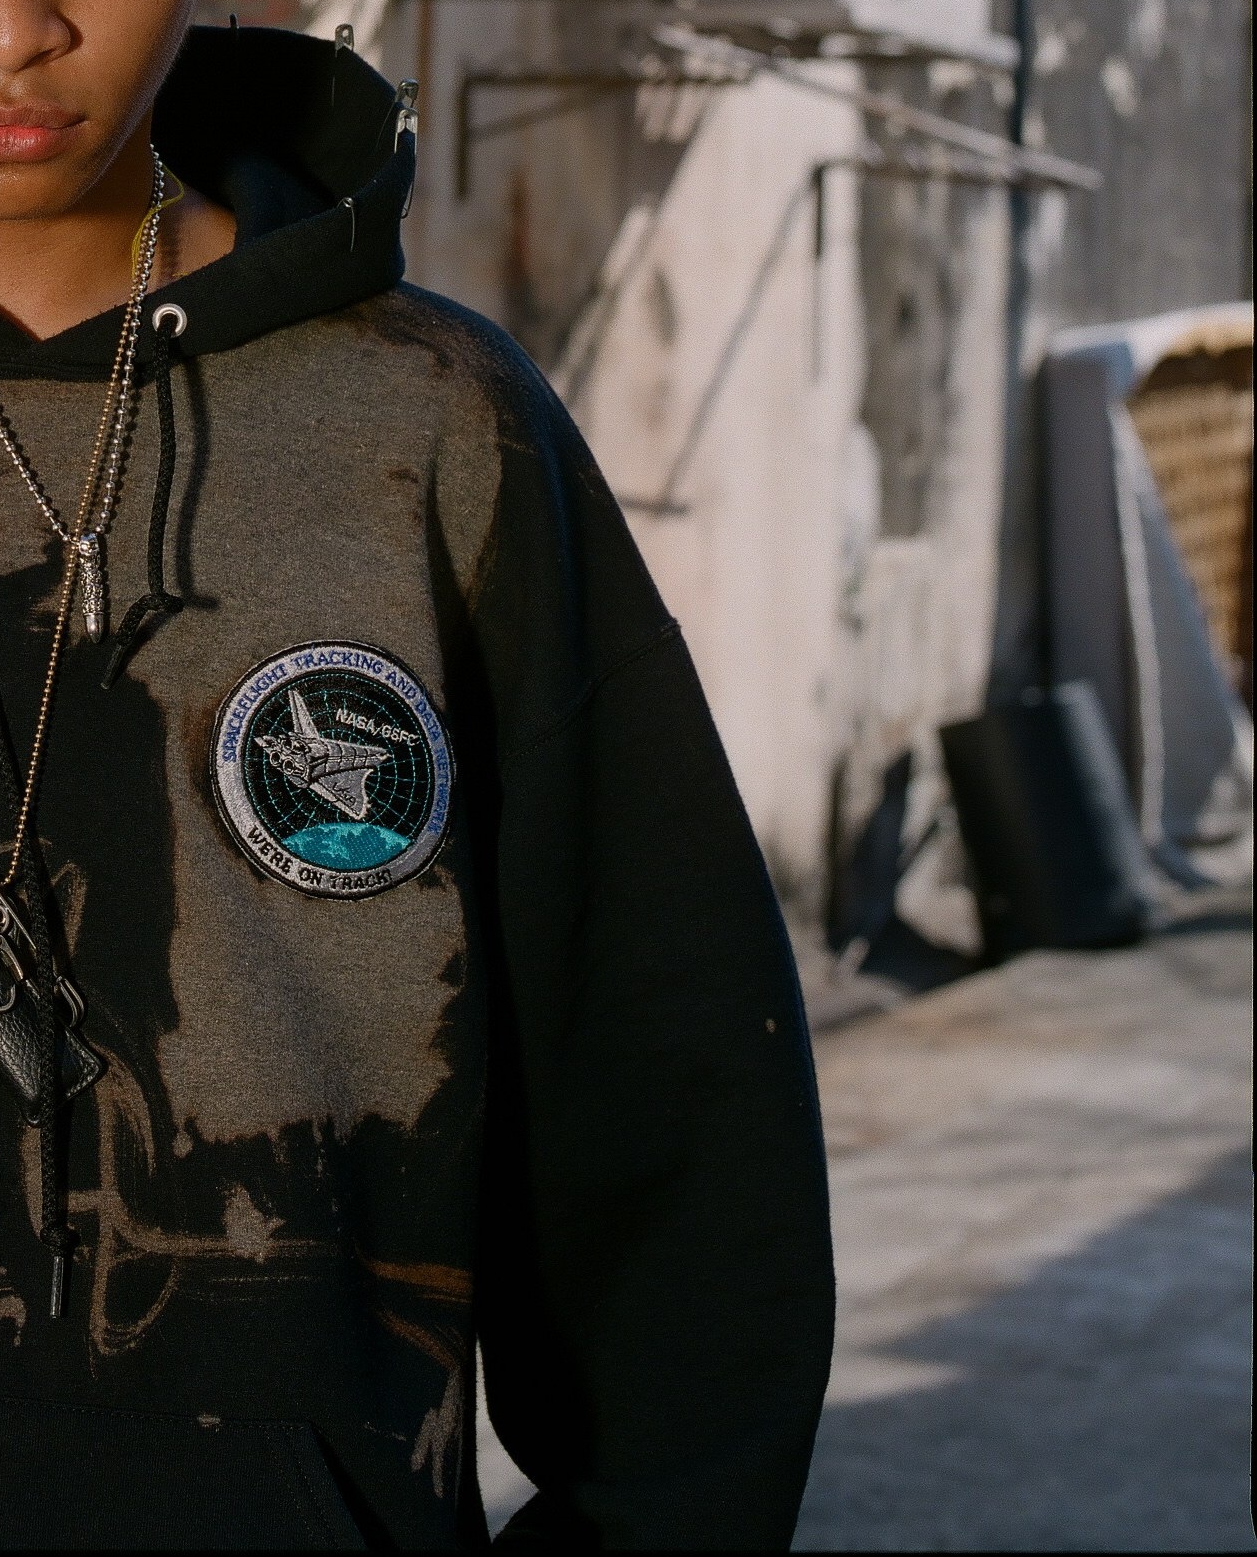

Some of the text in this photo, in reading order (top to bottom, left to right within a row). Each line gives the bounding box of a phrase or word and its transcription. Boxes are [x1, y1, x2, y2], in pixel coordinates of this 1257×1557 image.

[221, 664, 288, 763] SPACEFLIGHT
[292, 650, 384, 675] TRACKING
[384, 668, 418, 700] AND
[415, 698, 442, 742] DATA
[298, 866, 325, 886] ON
